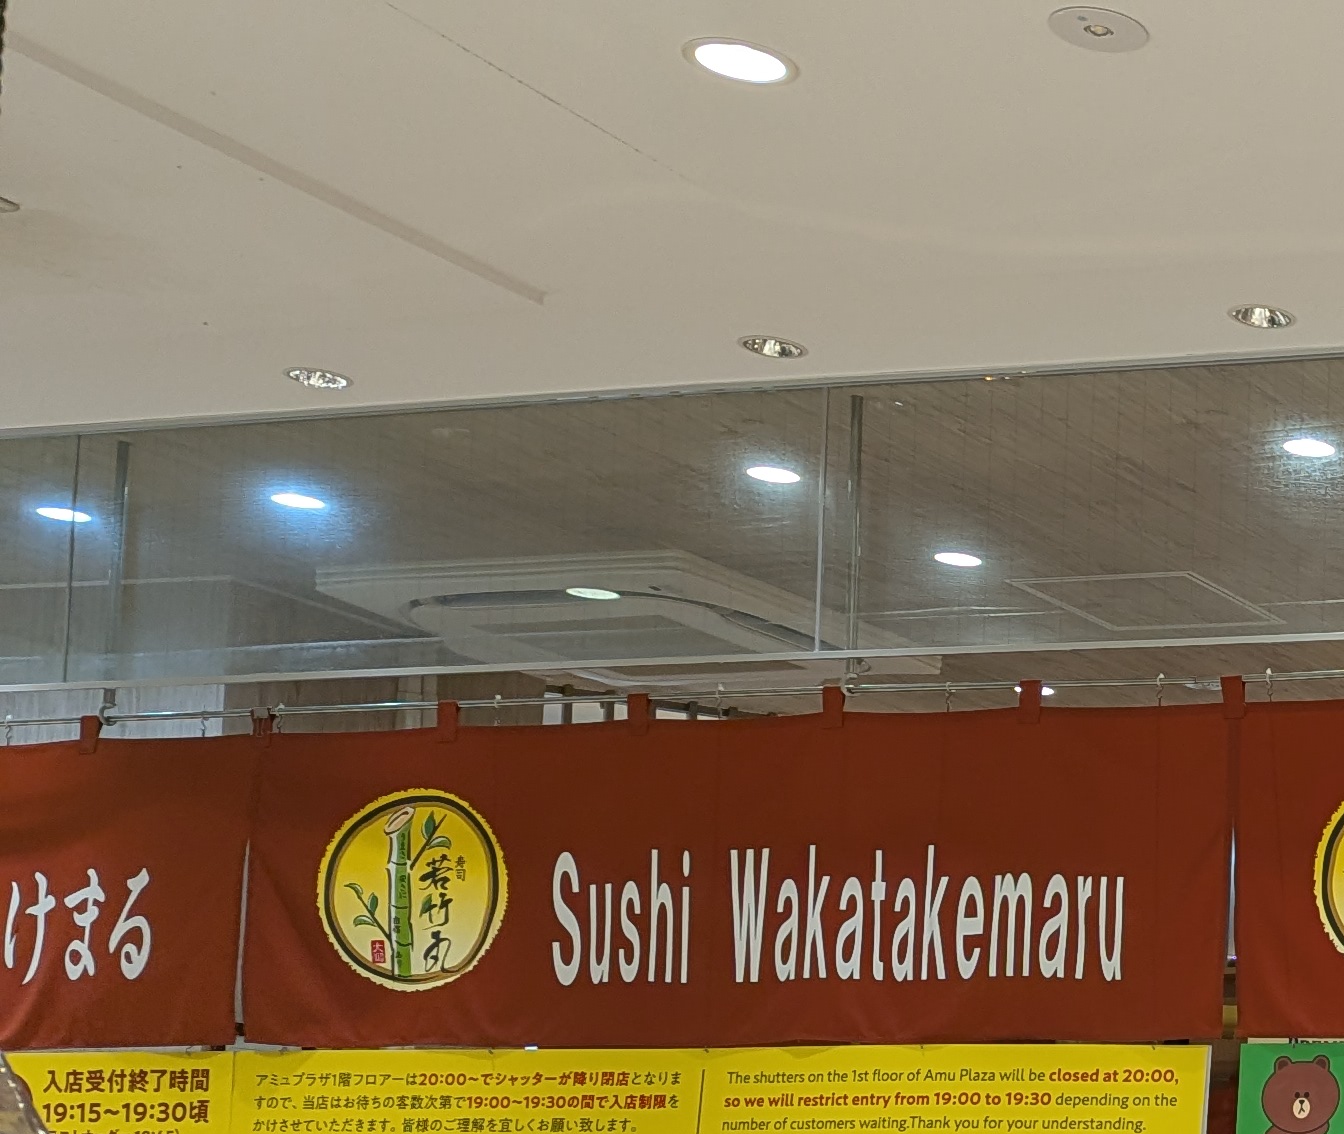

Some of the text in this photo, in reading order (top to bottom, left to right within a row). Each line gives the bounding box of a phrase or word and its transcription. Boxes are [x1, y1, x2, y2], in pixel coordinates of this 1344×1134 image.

[551, 843, 1125, 987] Sushi Wakatakemaru
[42, 1068, 210, 1093] 入店受付終了時間
[727, 1068, 1179, 1085] The shutters on the 1st floor of Amu Plaza will be closed at 20:00,
[723, 1091, 1178, 1110] so we will restrict entry from 19:00 to 19:30 depending on the
[721, 1117, 771, 1131] number
[773, 1116, 789, 1130] of
[790, 1117, 856, 1130] customers
[953, 1118, 980, 1132] you
[983, 1116, 1004, 1130] for
[1006, 1118, 1039, 1132] your
[1041, 1116, 1147, 1134] understanding.
